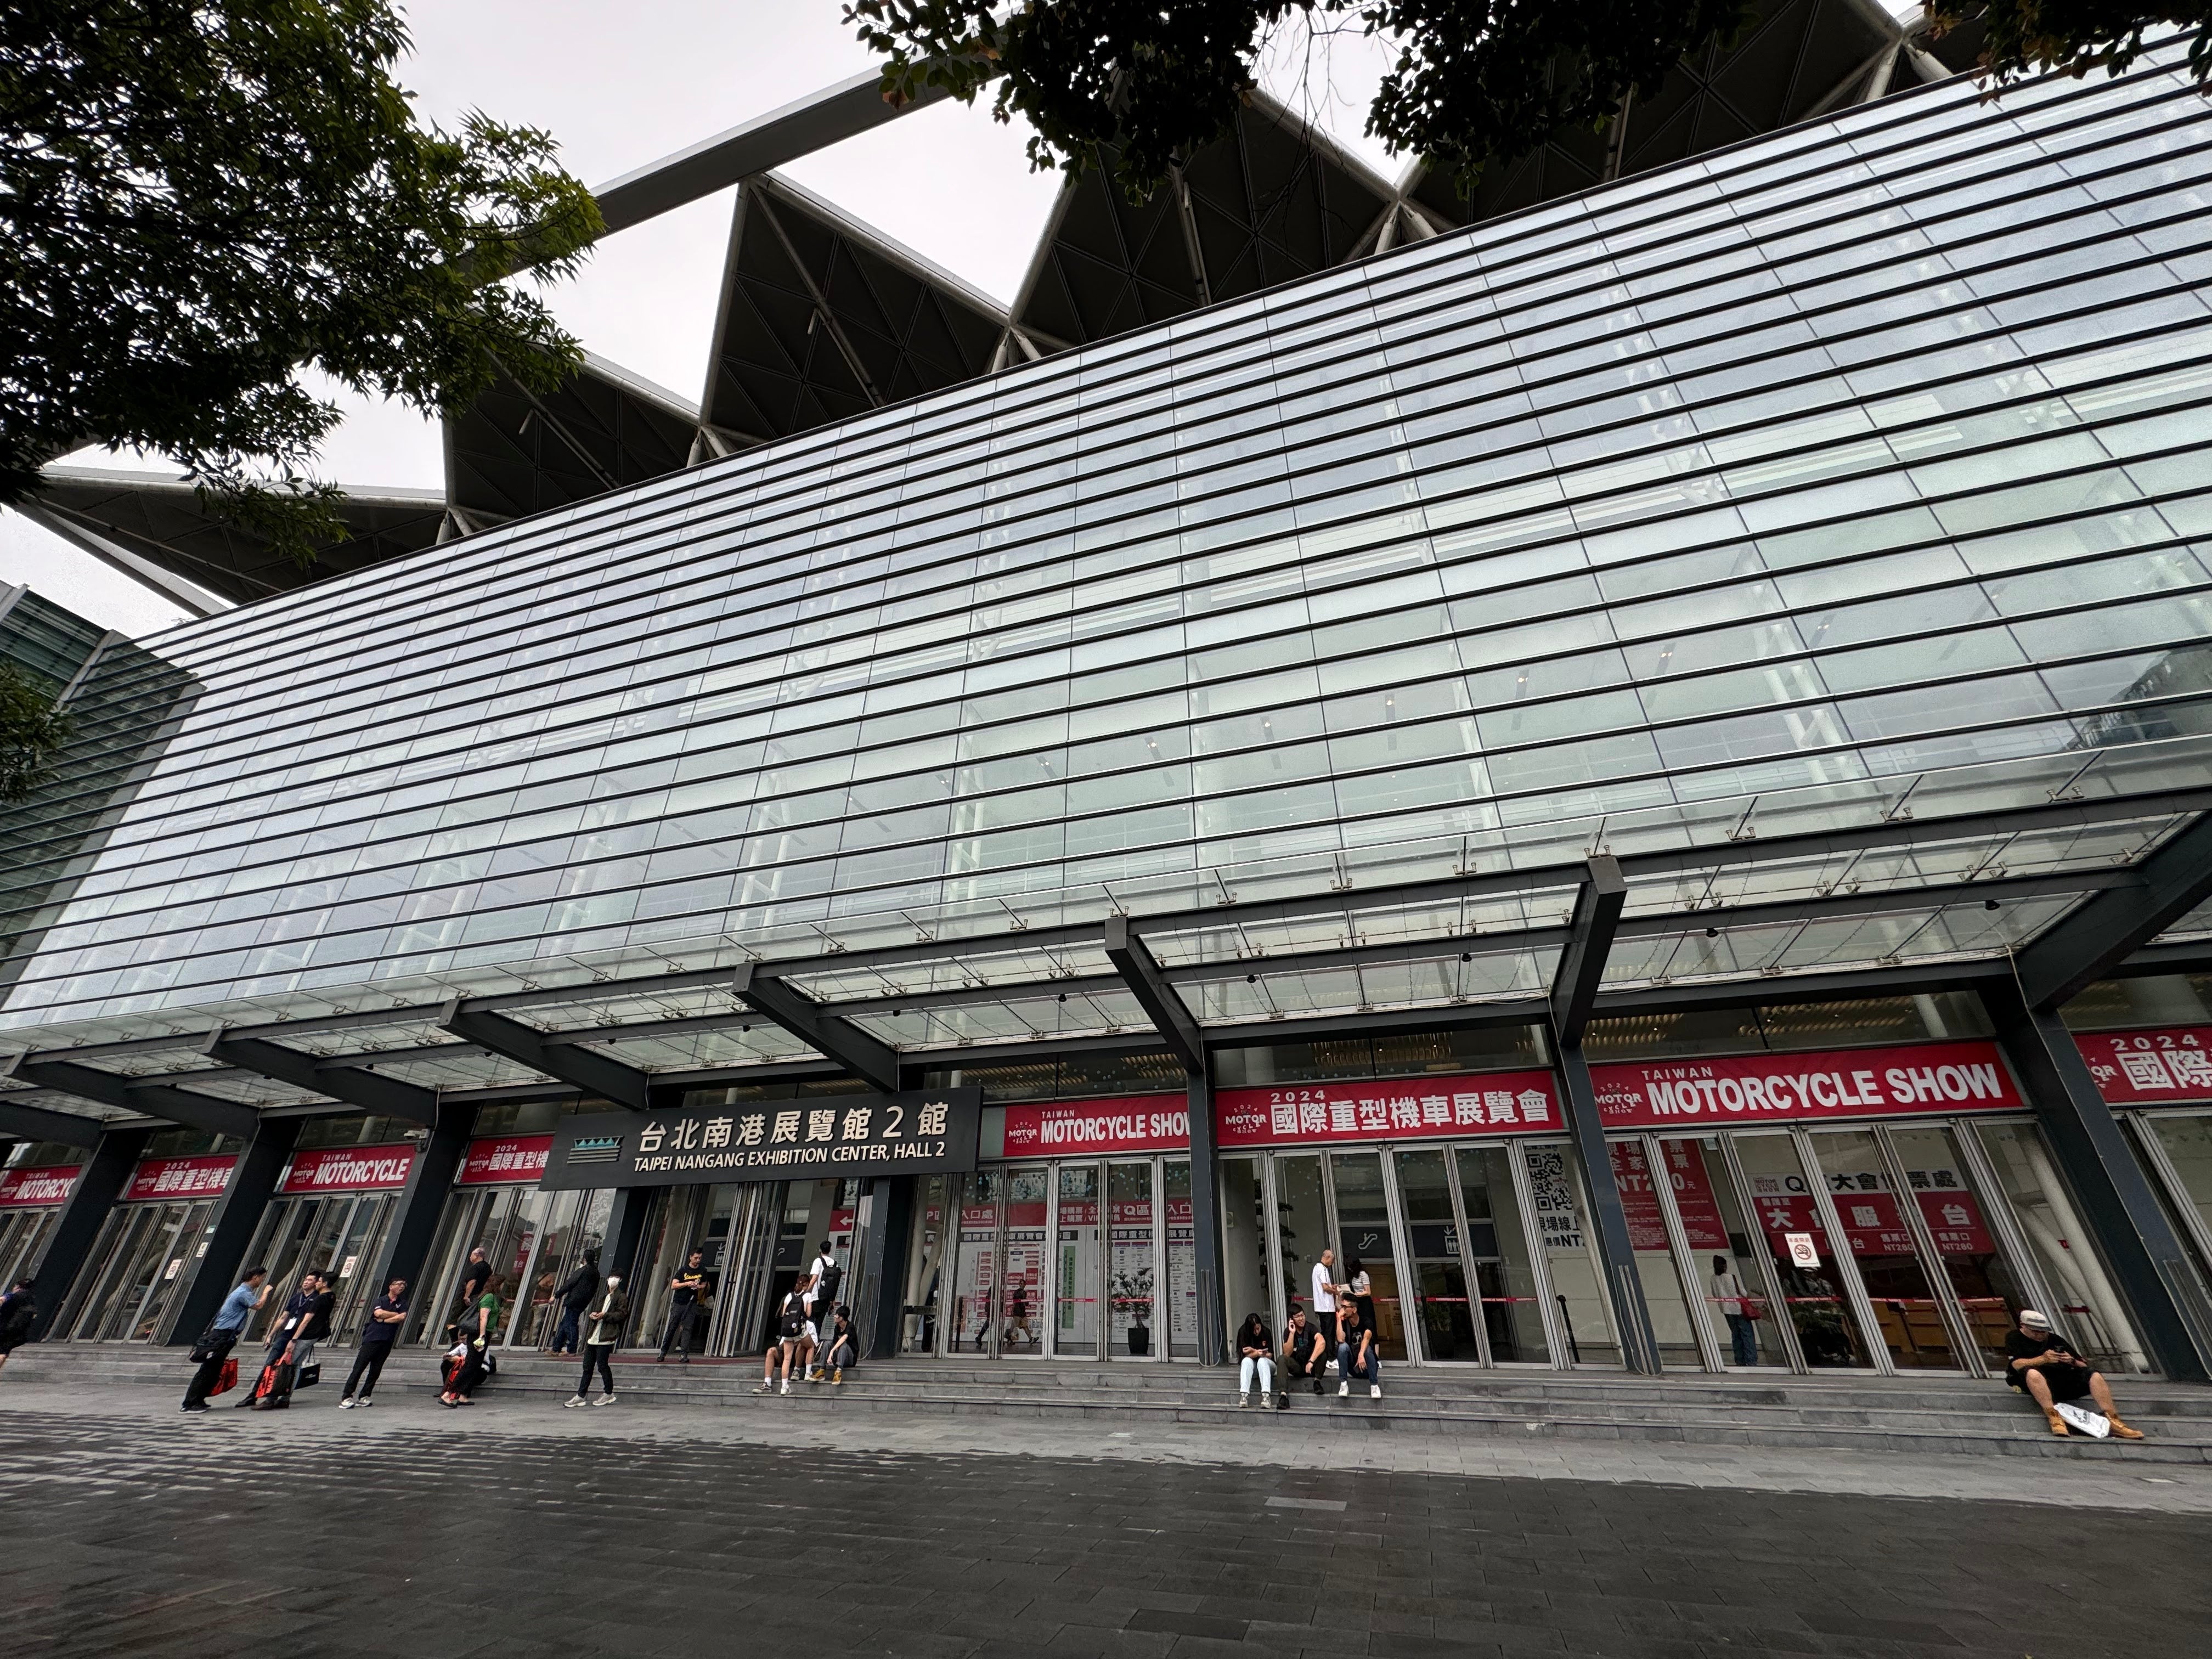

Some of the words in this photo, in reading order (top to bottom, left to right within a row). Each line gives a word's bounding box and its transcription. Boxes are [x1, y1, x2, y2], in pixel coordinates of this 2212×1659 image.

[2110, 1034, 2199, 1051] 2024
[1641, 1066, 1713, 1080] TAIWAN
[1646, 1070, 1885, 1115] MOTORCYCLE
[1886, 1063, 2003, 1103] SHOW
[1271, 1090, 1325, 1103] 2024
[1594, 1093, 1643, 1104] MOTOR
[1042, 1109, 1075, 1119] TAIWAN
[1271, 1089, 1549, 1135] 國際重型機車展覽會
[1225, 1114, 1267, 1125] MOTOR
[1009, 1128, 1037, 1137] MOTOR
[1041, 1114, 1146, 1143] MOTORCYCLE
[495, 1144, 517, 1153] 2024
[322, 1153, 352, 1161] TAIWAN
[634, 1156, 673, 1172] TAIPEI
[675, 1152, 744, 1170] NANGANG
[747, 1147, 828, 1166] EXHIBITION
[832, 1144, 890, 1161] CENTER,
[894, 1142, 932, 1159] HALL
[935, 1141, 945, 1156] 2
[164, 1161, 191, 1170] 2024
[312, 1158, 410, 1185] MOTORCYCLE
